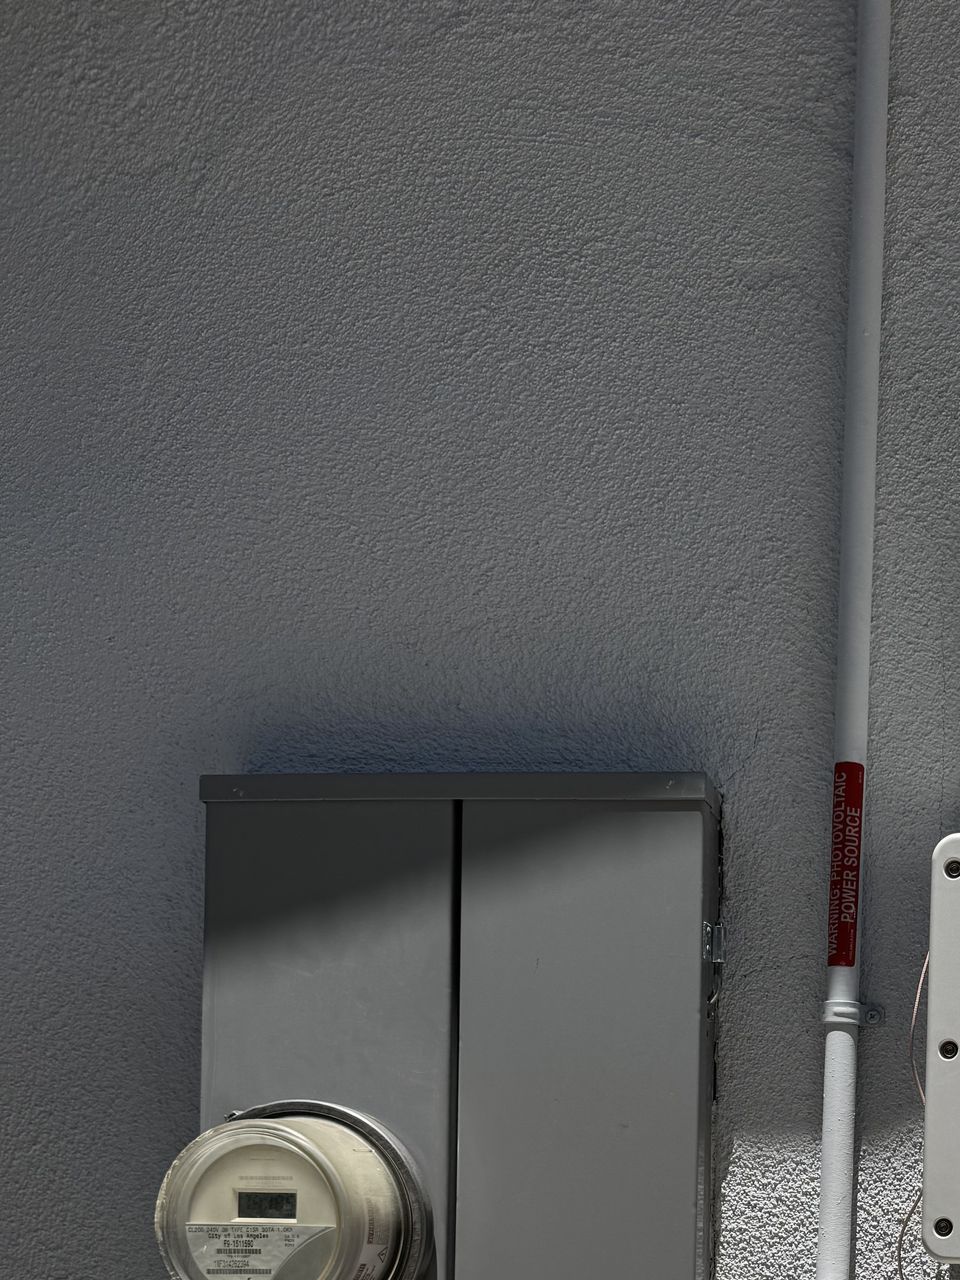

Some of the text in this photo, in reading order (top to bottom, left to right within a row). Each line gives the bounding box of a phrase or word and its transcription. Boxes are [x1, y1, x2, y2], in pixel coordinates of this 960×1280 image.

[828, 771, 847, 956] WARNING: PHOTOVOLTAIC
[841, 807, 861, 922] POWER SOURCE
